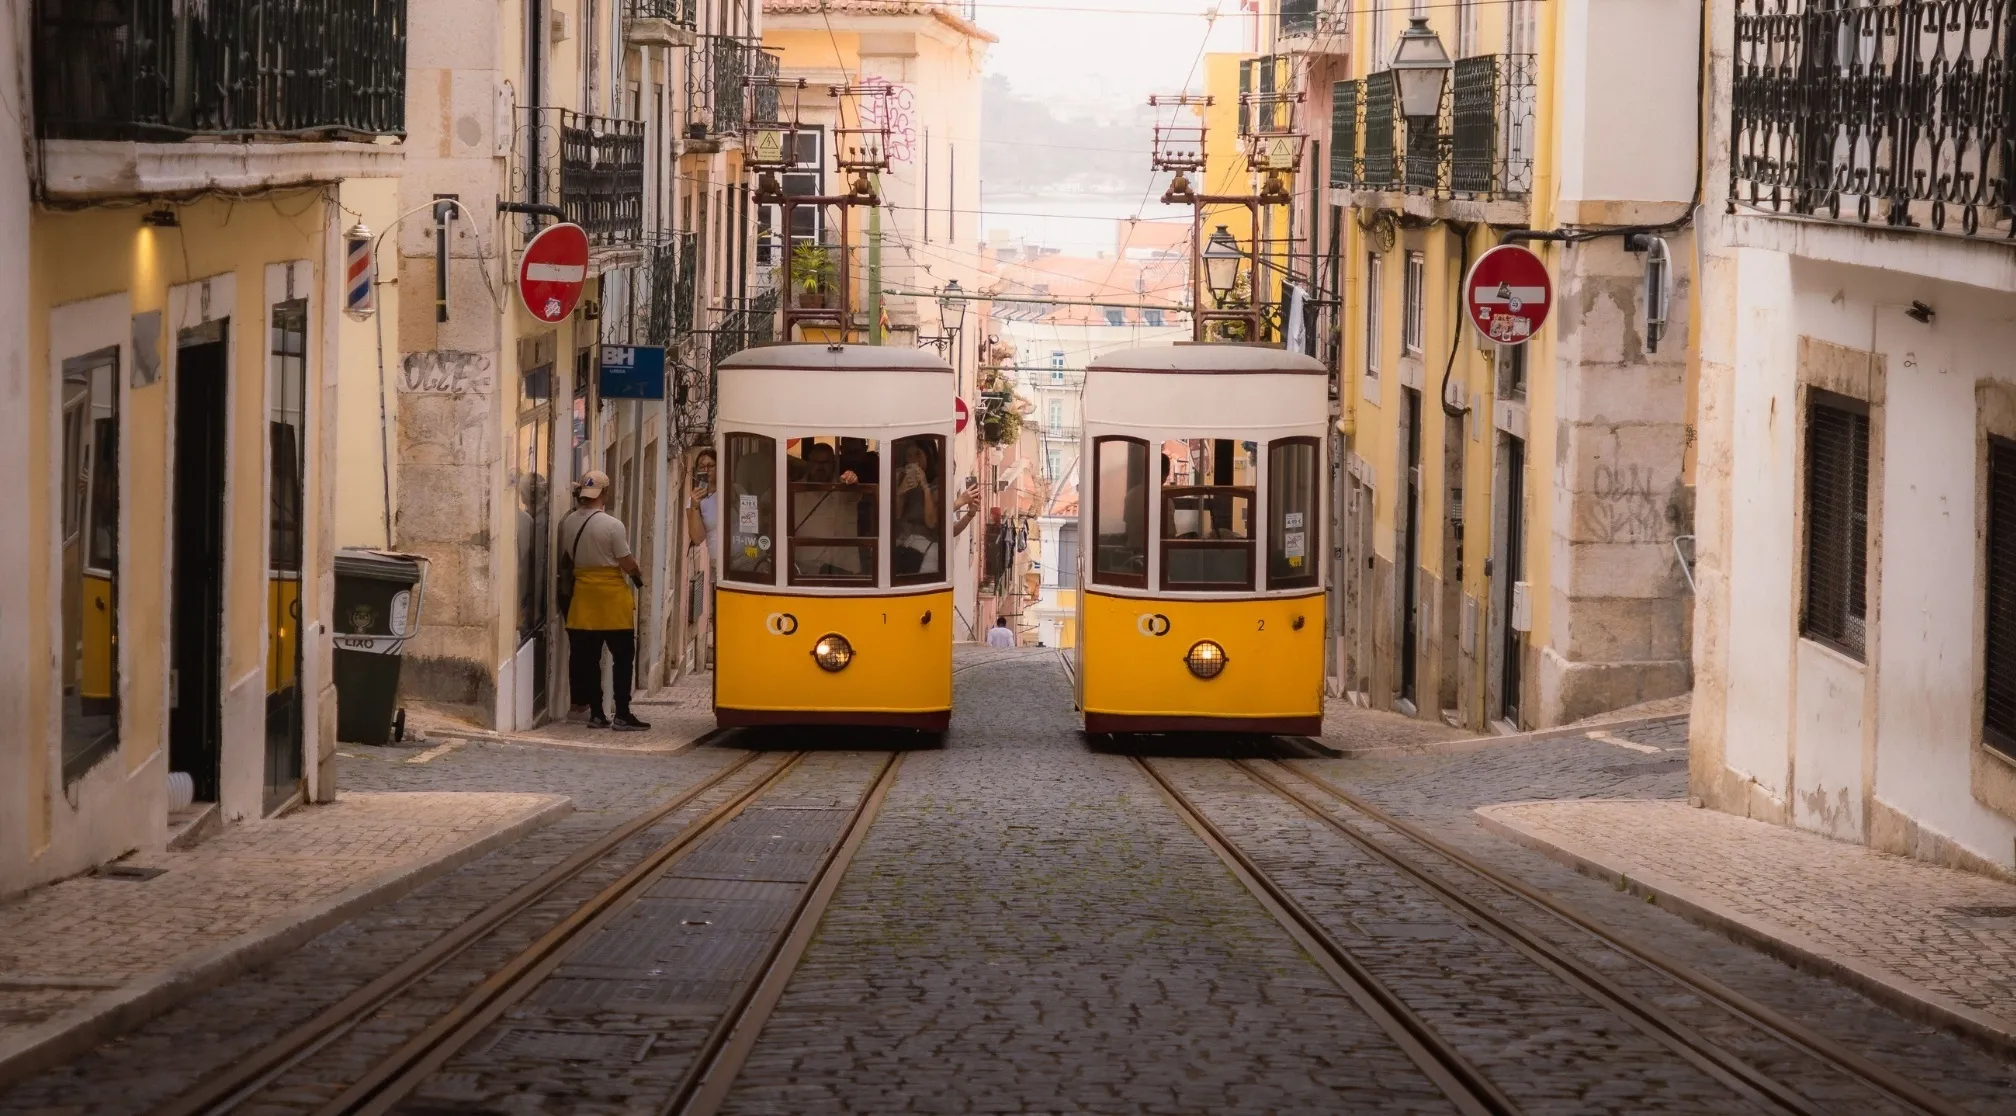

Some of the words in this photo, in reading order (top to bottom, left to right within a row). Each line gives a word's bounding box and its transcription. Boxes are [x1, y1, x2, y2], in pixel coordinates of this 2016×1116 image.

[602, 347, 635, 365] BH
[881, 613, 887, 624] 1
[1257, 619, 1265, 631] 2
[345, 638, 374, 649] LIXO
